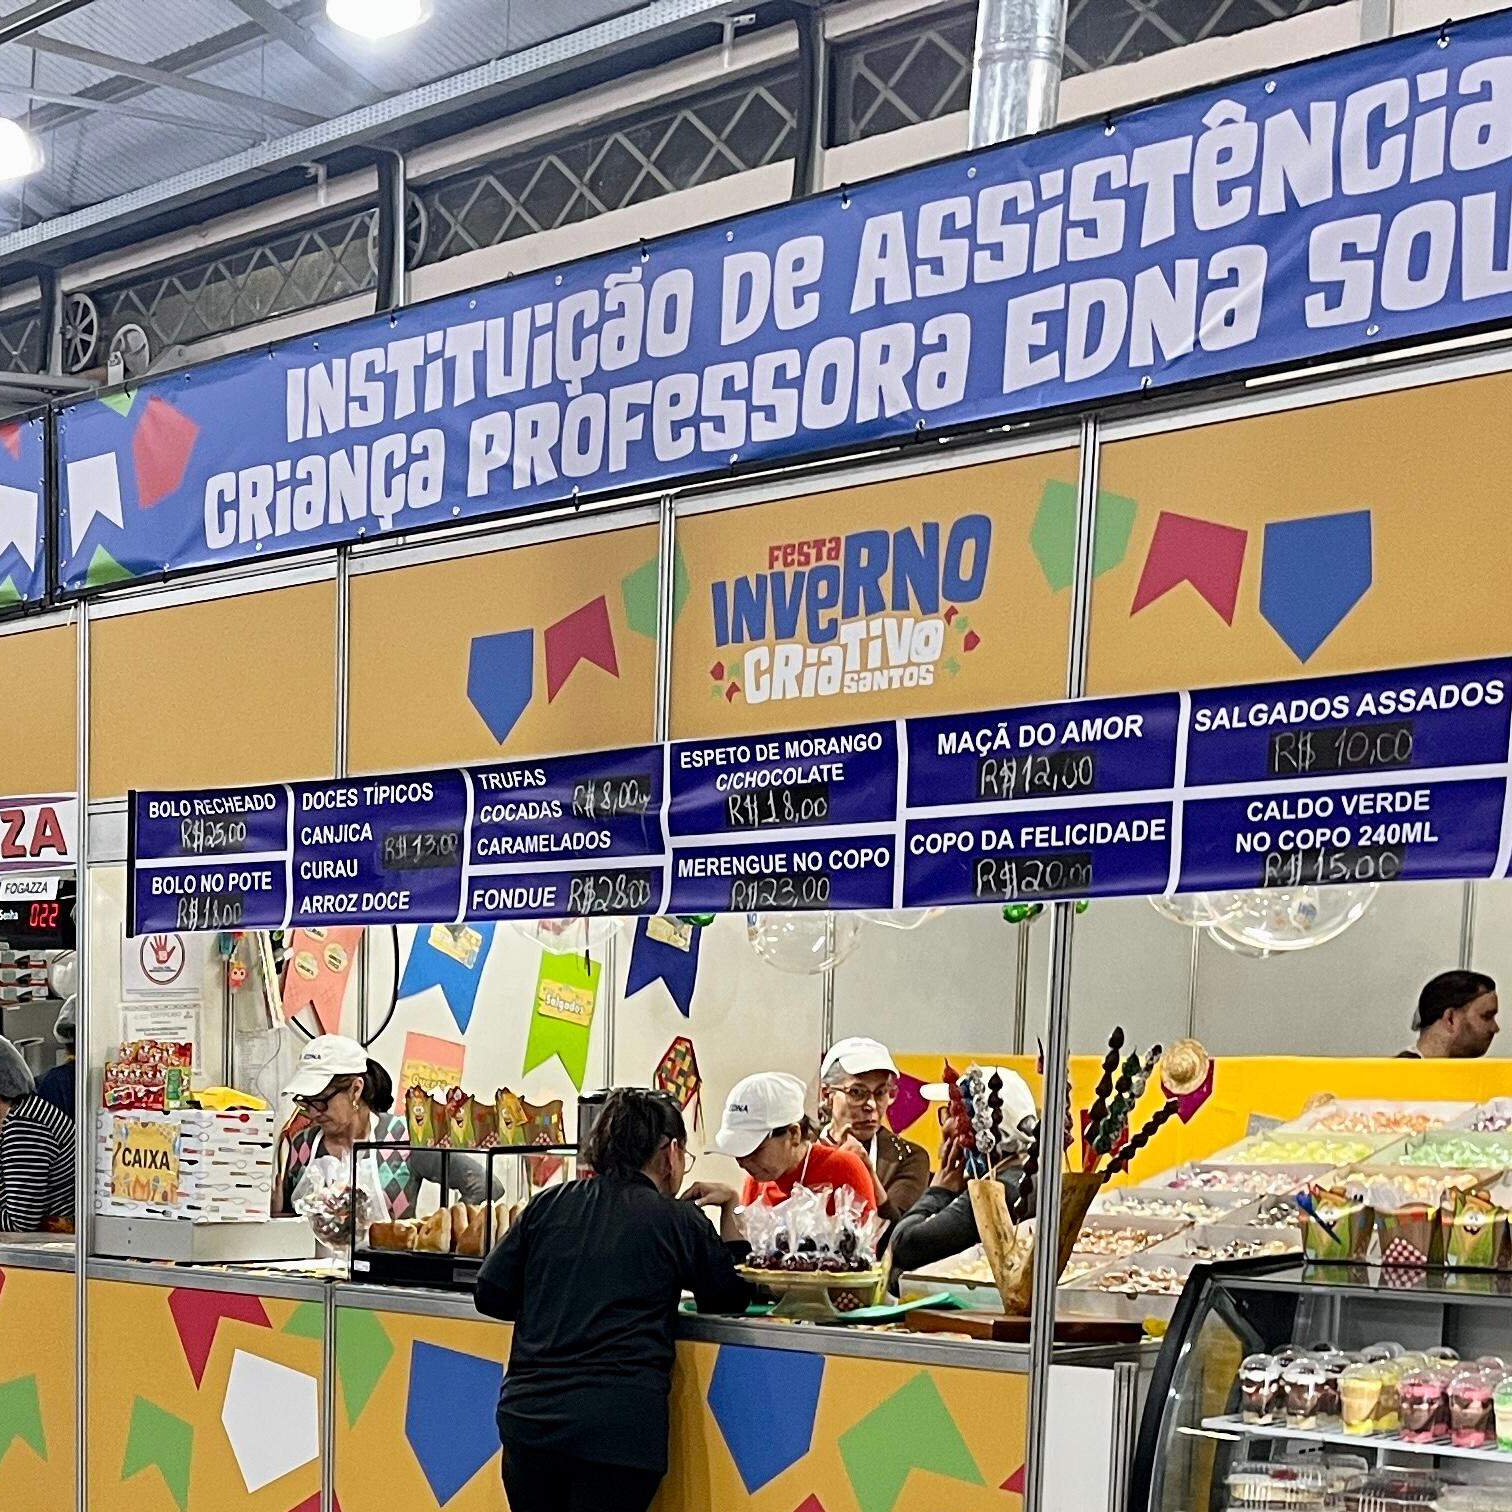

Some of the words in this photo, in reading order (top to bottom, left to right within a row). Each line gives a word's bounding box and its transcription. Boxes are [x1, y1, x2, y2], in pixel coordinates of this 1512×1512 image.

[1194, 695, 1348, 732] SALGADOS
[1356, 679, 1505, 717] ASSADOS
[937, 722, 1011, 756] MAÇÃ
[1019, 725, 1055, 748] DO
[1061, 714, 1143, 744] AMOR
[680, 745, 750, 769] ESPETO
[755, 741, 780, 762] DE
[784, 732, 883, 759] MORANGO
[478, 769, 547, 790] TRUFAS
[716, 763, 845, 791] C/CHOCOLATE
[149, 800, 191, 819] BOLO
[194, 793, 277, 816] RECHEADO
[302, 789, 359, 811] DOCES
[363, 781, 434, 806] TÍPICOS
[1247, 796, 1333, 822] CALDO
[1341, 789, 1430, 816] VERDE
[480, 800, 563, 824] COCADAS
[300, 823, 373, 846] CANJICA
[477, 830, 611, 856] CARAMELADOS
[910, 831, 974, 855] COPO
[981, 829, 1014, 850] DA
[1021, 819, 1166, 848] FELICIDADE
[1236, 831, 1271, 853] NO
[1278, 827, 1351, 850] COPO
[1358, 822, 1438, 846] 240ML
[300, 859, 359, 881] CURAU
[678, 853, 787, 878] MERENGUE
[793, 851, 823, 872] NO
[828, 847, 890, 870] COPO
[5, 881, 48, 894] FOGAZZA
[152, 875, 197, 895] BOLO
[200, 873, 225, 893] NO
[228, 871, 272, 892] POTE
[300, 893, 358, 914] ARROZ
[361, 891, 410, 912] DOCE
[472, 886, 557, 911] FONDUE
[30, 904, 59, 927] 022
[122, 1147, 171, 1171] CAIXA
